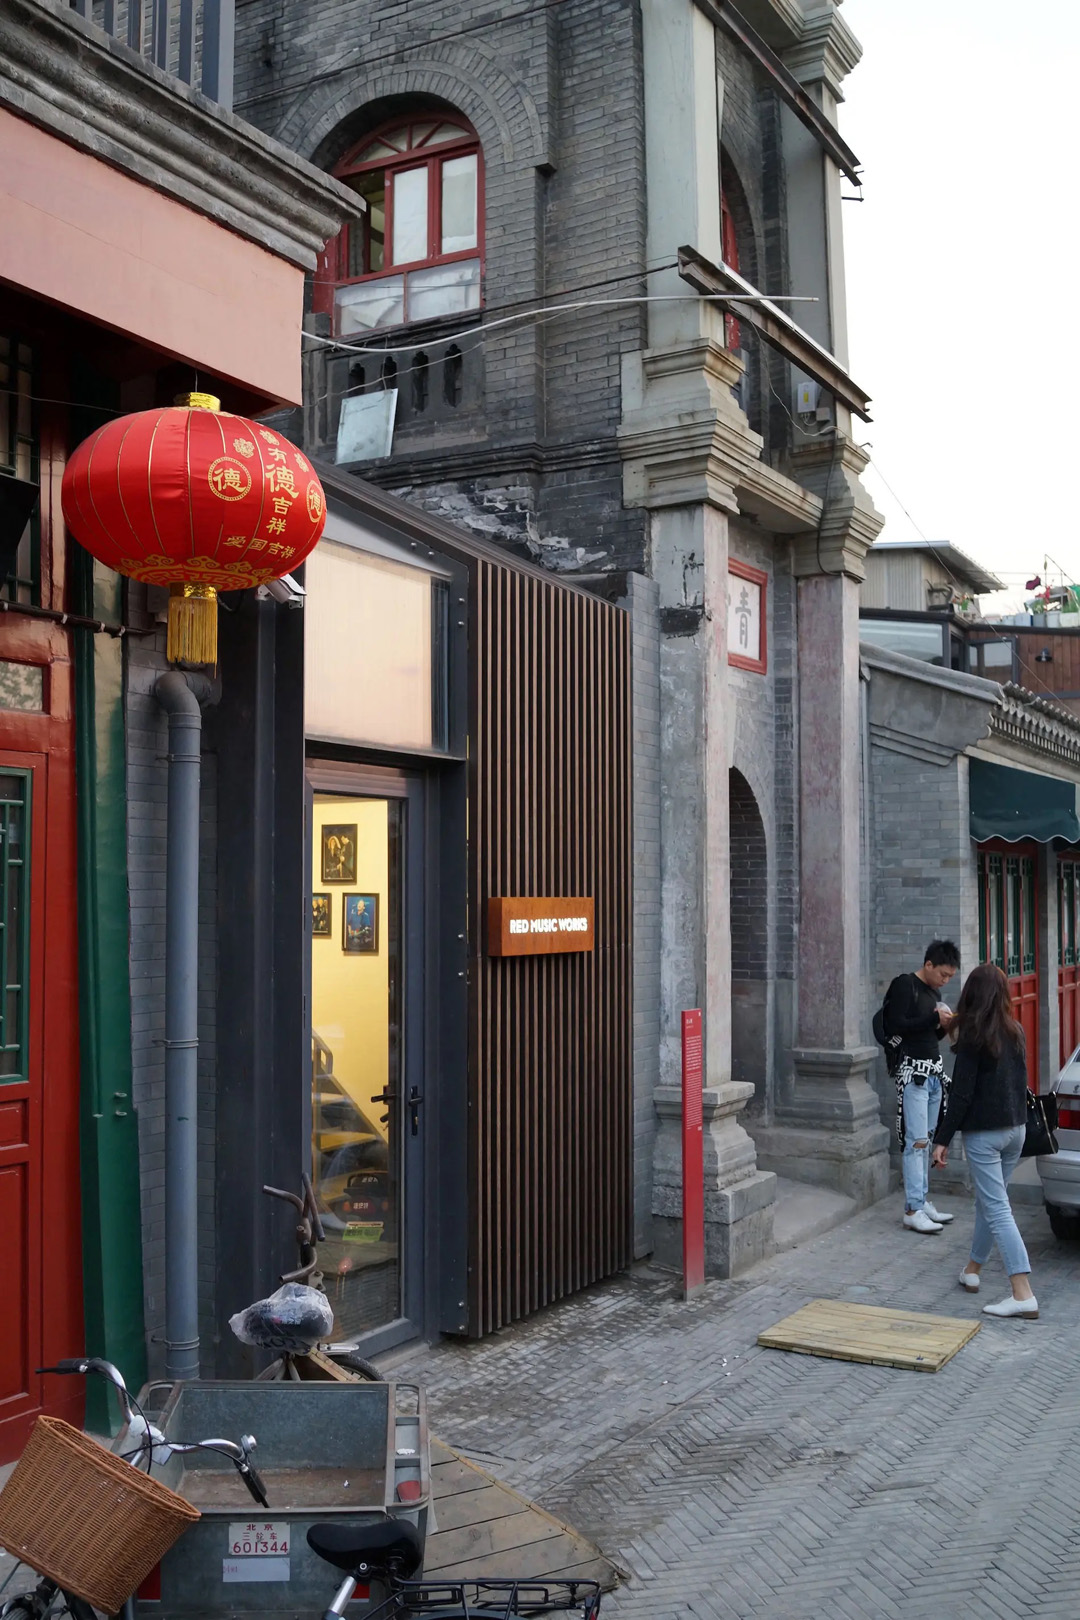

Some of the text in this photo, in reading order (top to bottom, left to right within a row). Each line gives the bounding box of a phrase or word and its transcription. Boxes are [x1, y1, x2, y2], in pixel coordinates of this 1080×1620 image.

[213, 468, 247, 493] 德
[265, 448, 299, 535] 有德吉祥
[510, 917, 588, 934] RED MUSIC WORKS
[243, 1532, 277, 1541] 三轮车
[232, 1541, 289, 1554] 601344
